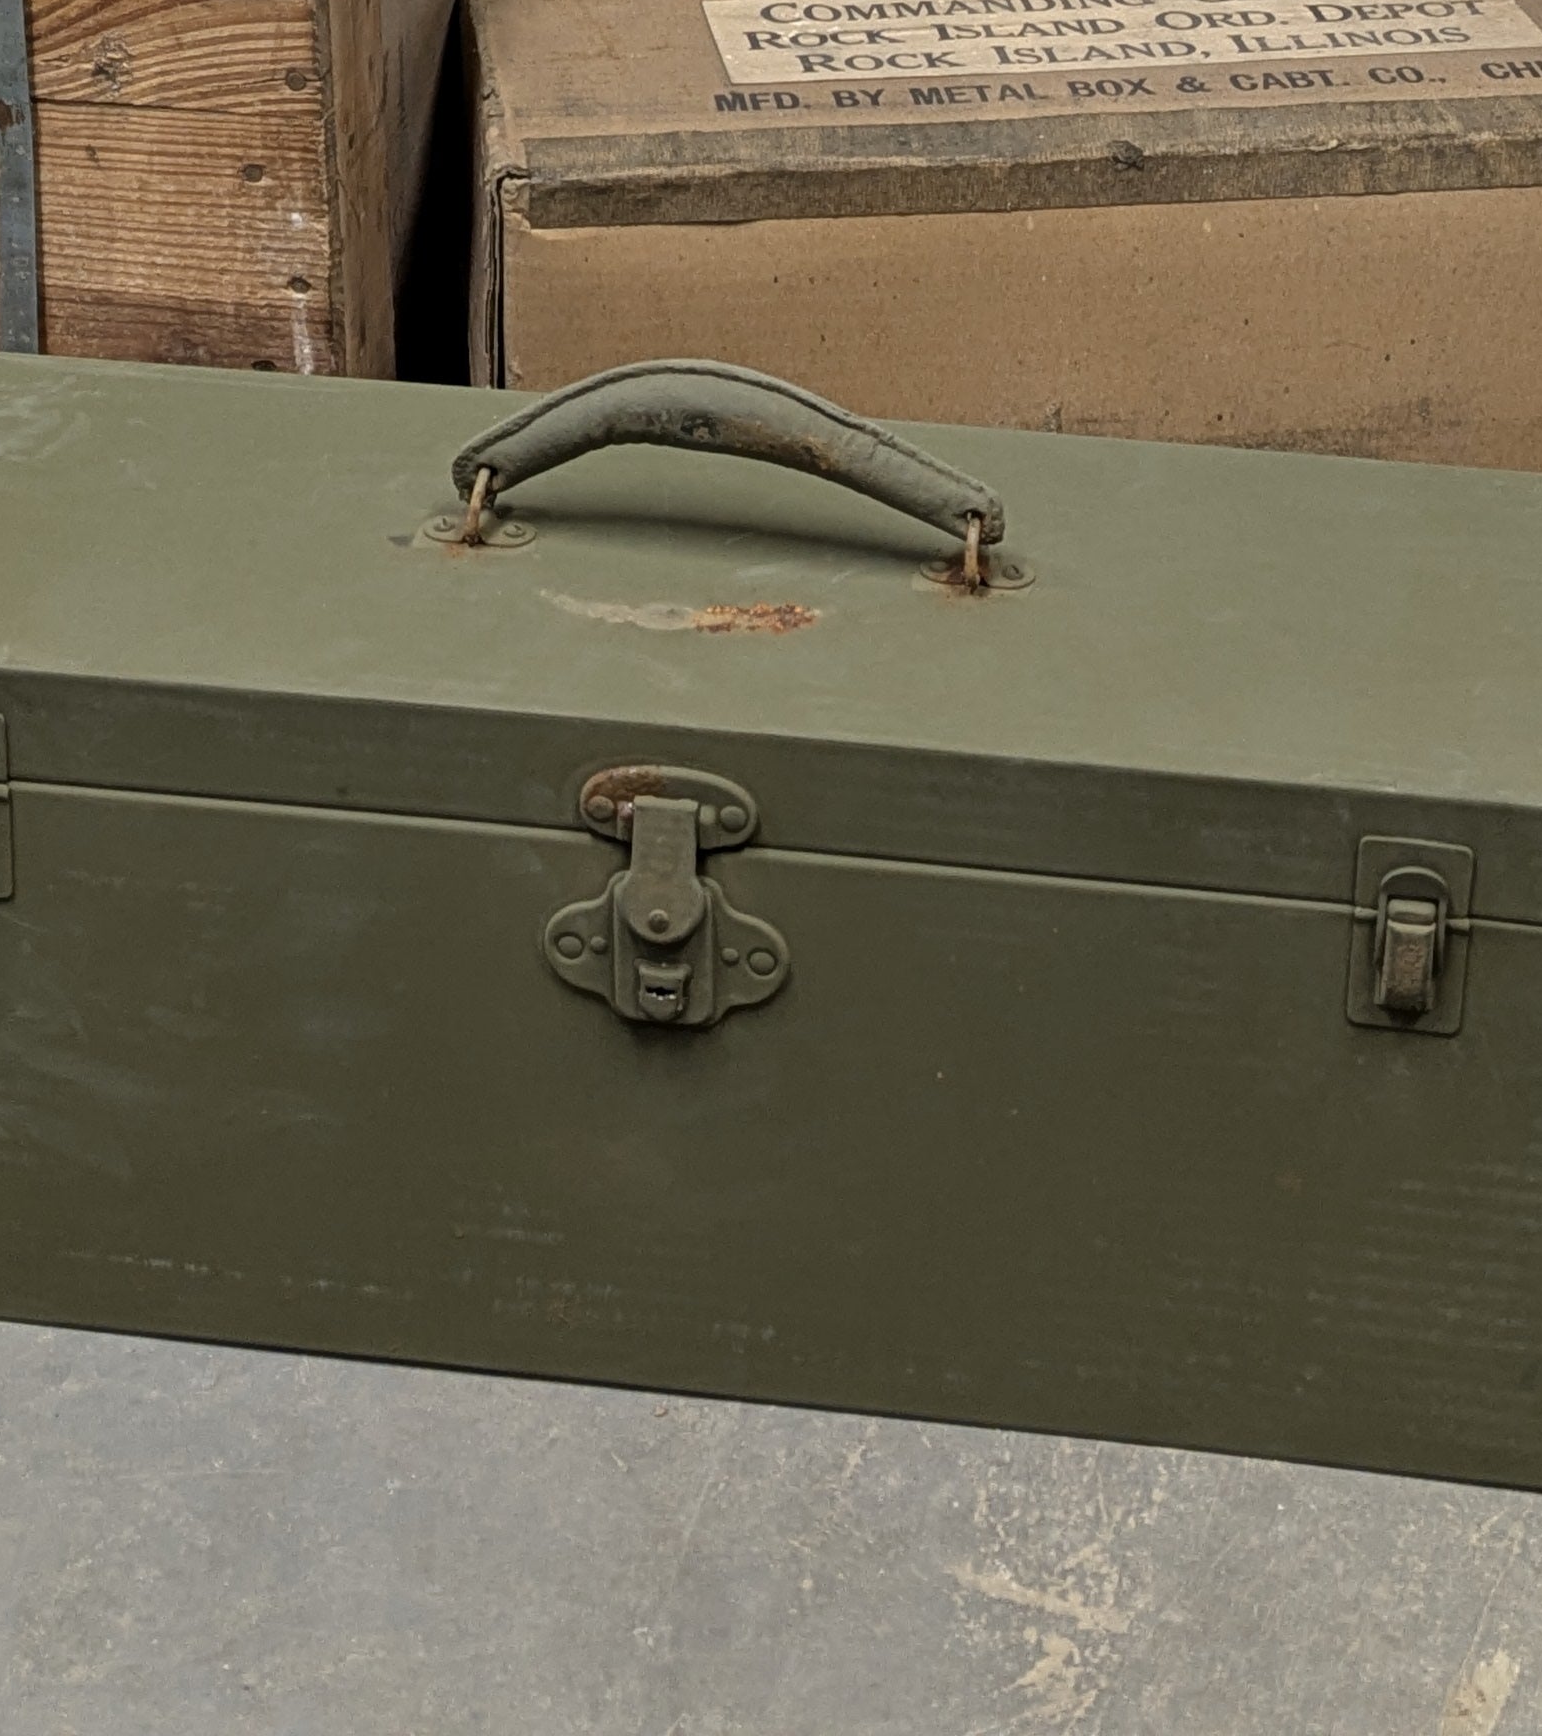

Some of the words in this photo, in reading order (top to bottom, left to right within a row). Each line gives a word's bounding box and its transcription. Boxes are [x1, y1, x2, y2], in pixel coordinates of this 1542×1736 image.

[746, 27, 907, 51] ROCK
[937, 16, 1126, 43] ISLAND
[1154, 6, 1290, 32] ORD.
[1305, 0, 1486, 24] DEPOT
[798, 51, 963, 75] ROCK
[995, 37, 1210, 65] ISLAND,
[1235, 26, 1472, 54] ILLINOIS
[714, 91, 811, 113] MFD.
[833, 87, 883, 109] BY
[910, 82, 1049, 107] METAL
[1067, 76, 1154, 99] BOX
[1175, 74, 1210, 94] &
[1231, 68, 1350, 92] CABT.
[1367, 65, 1448, 86] CO.,
